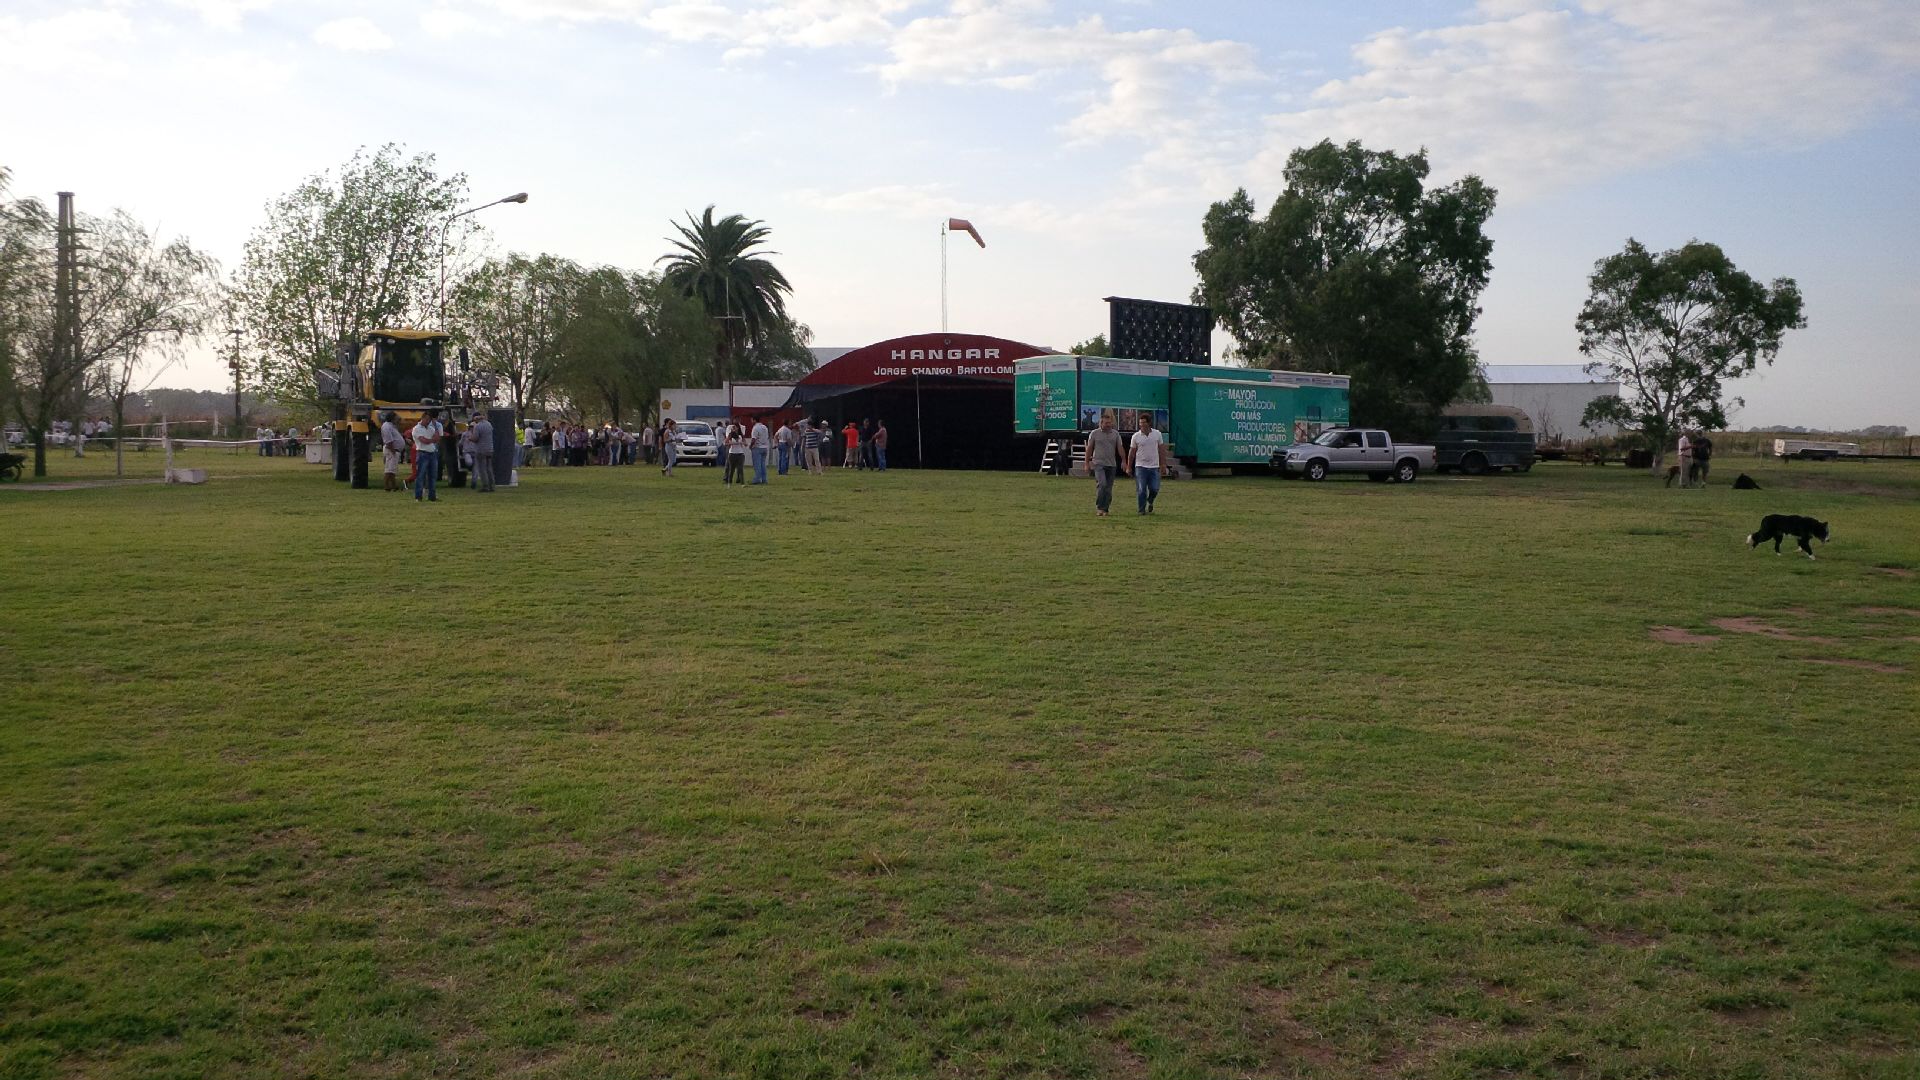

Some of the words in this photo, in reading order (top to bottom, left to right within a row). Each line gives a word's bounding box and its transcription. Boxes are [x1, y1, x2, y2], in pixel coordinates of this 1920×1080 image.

[891, 348, 1000, 359] HANGAR
[873, 366, 907, 376] JORGE
[911, 367, 953, 375] CHANGO
[957, 365, 1014, 375] BARTOLOM
[1228, 388, 1257, 401] MAYOR
[1231, 411, 1246, 420] CON
[1247, 410, 1262, 421] MÁS
[1224, 432, 1252, 441] TRABAJO
[1257, 433, 1287, 442] ALIMENTO
